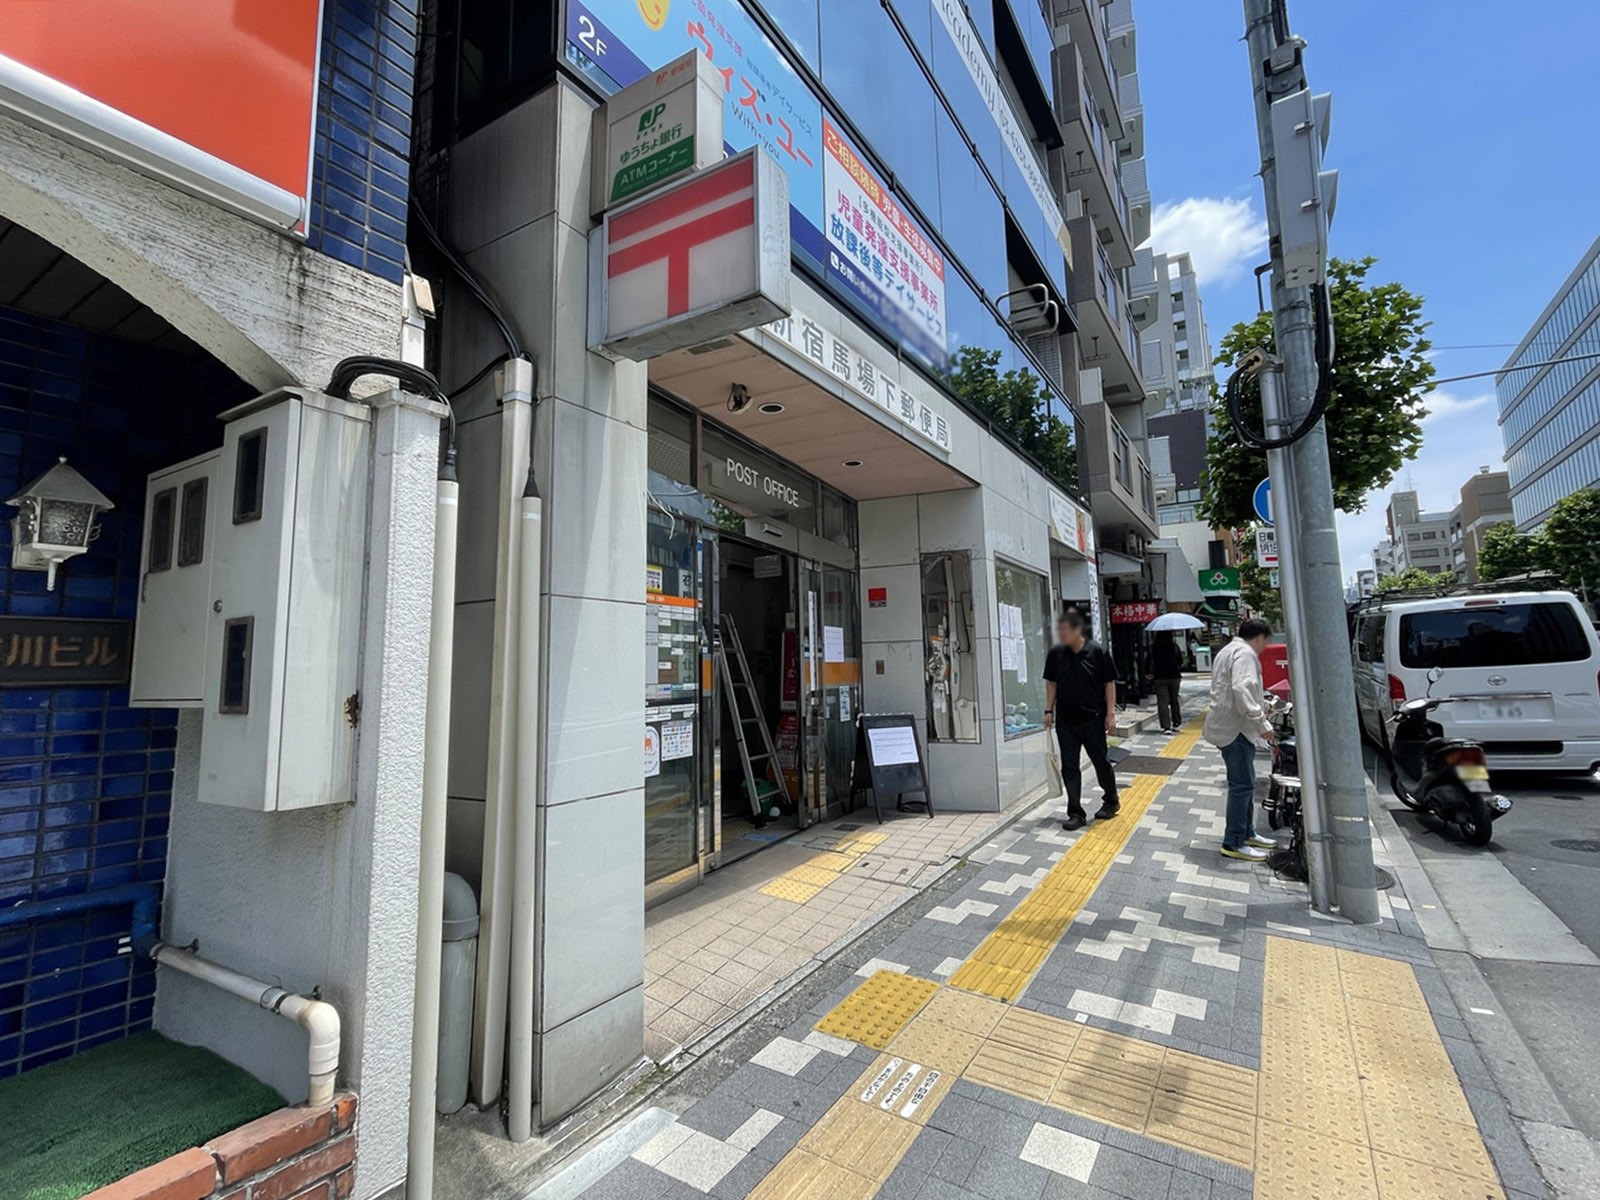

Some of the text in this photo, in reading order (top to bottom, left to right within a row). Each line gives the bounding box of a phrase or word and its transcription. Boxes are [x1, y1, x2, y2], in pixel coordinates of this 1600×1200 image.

[578, 15, 607, 57] 2F
[638, 102, 667, 132] JP
[620, 123, 683, 165] ゆうちょ銀行
[620, 147, 688, 186] ATMコーナー
[837, 188, 939, 314] 児童発達支援事業所
[830, 213, 943, 339] 放課後等デイサービス
[726, 457, 800, 509] POST OFFICE
[1112, 603, 1158, 617] 本格中華
[0, 633, 118, 667] 川ビル
